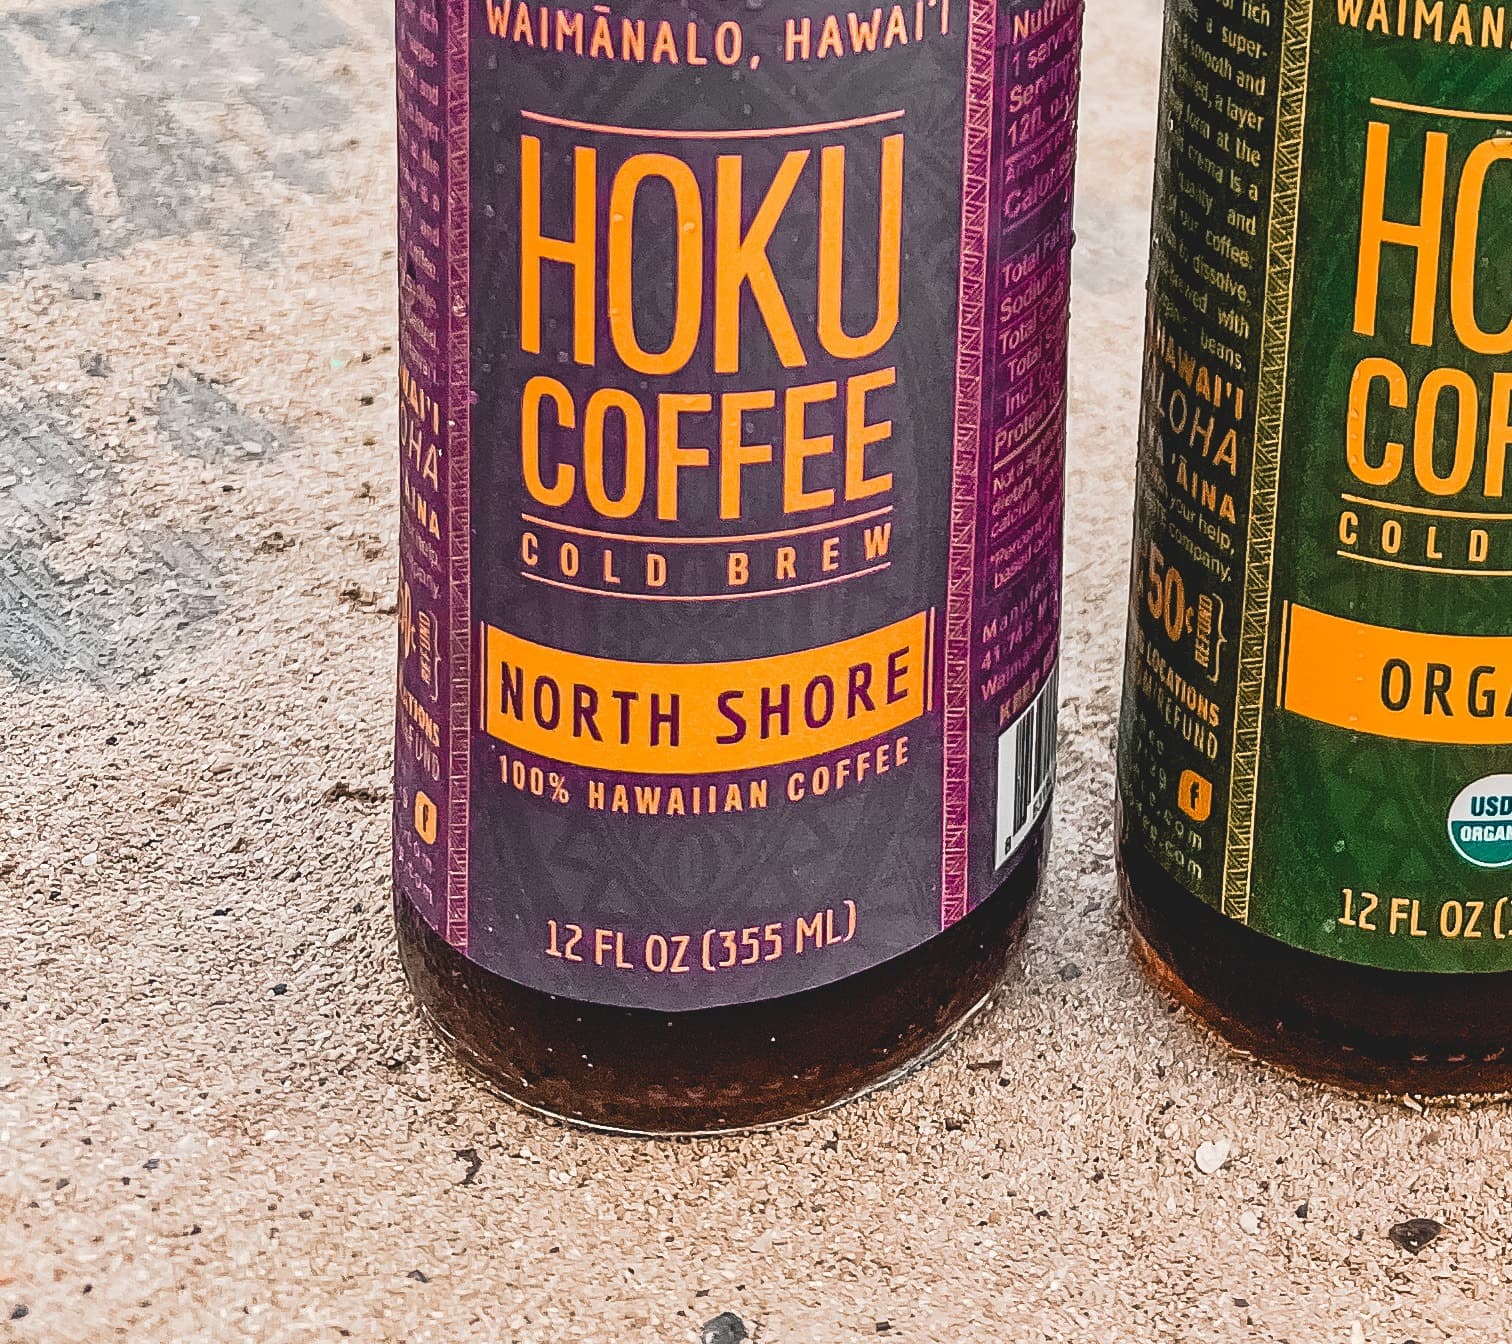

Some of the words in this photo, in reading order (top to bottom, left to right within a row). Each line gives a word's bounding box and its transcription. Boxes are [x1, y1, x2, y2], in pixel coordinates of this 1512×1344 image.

[1236, 68, 1267, 97] and
[1226, 95, 1266, 133] layer
[1235, 135, 1262, 169] the
[1248, 183, 1259, 203] a
[1226, 206, 1257, 237] and
[520, 133, 905, 375] HOKU
[520, 367, 898, 522] COFFEE
[520, 531, 668, 587] COLD
[727, 522, 894, 586] BREW
[1338, 511, 1489, 563] COLD
[500, 660, 682, 747] NORTH
[715, 646, 911, 745] SHORE
[498, 753, 570, 805] 100%
[588, 778, 769, 817] HAWAIIAN
[787, 736, 911, 802] COFFEE
[544, 919, 584, 960] 12
[594, 928, 634, 970] FL
[645, 934, 690, 973] OZ
[702, 921, 785, 971] (355
[795, 899, 857, 955] ML)
[1338, 888, 1378, 929] 12
[1389, 897, 1427, 937] FL
[1440, 899, 1482, 938] OZ
